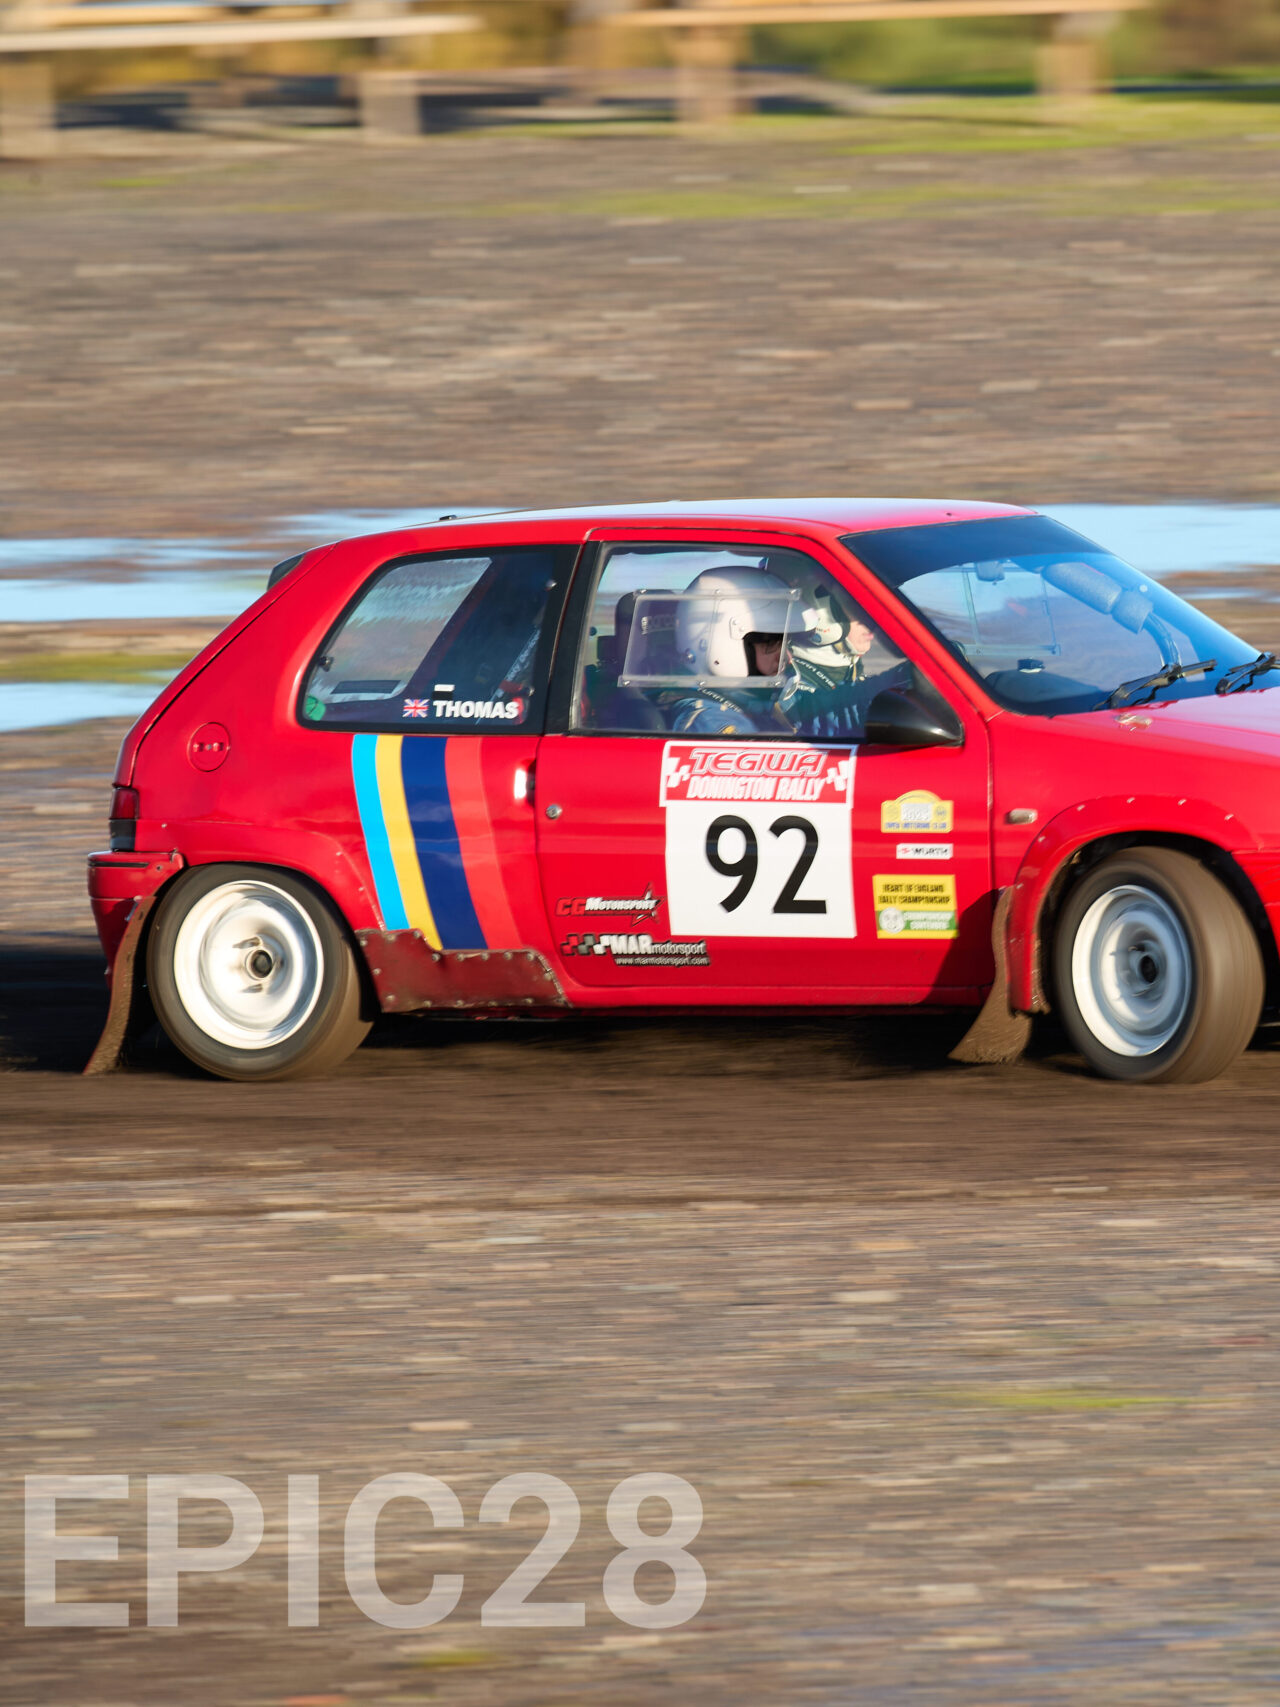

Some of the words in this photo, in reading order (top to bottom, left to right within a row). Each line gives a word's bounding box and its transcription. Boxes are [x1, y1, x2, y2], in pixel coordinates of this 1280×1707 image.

[433, 700, 520, 719] THOMAS
[689, 748, 828, 777] TEGIWA
[686, 776, 778, 800] DONINGTON
[775, 777, 827, 801] RALLY
[705, 815, 827, 914] 92
